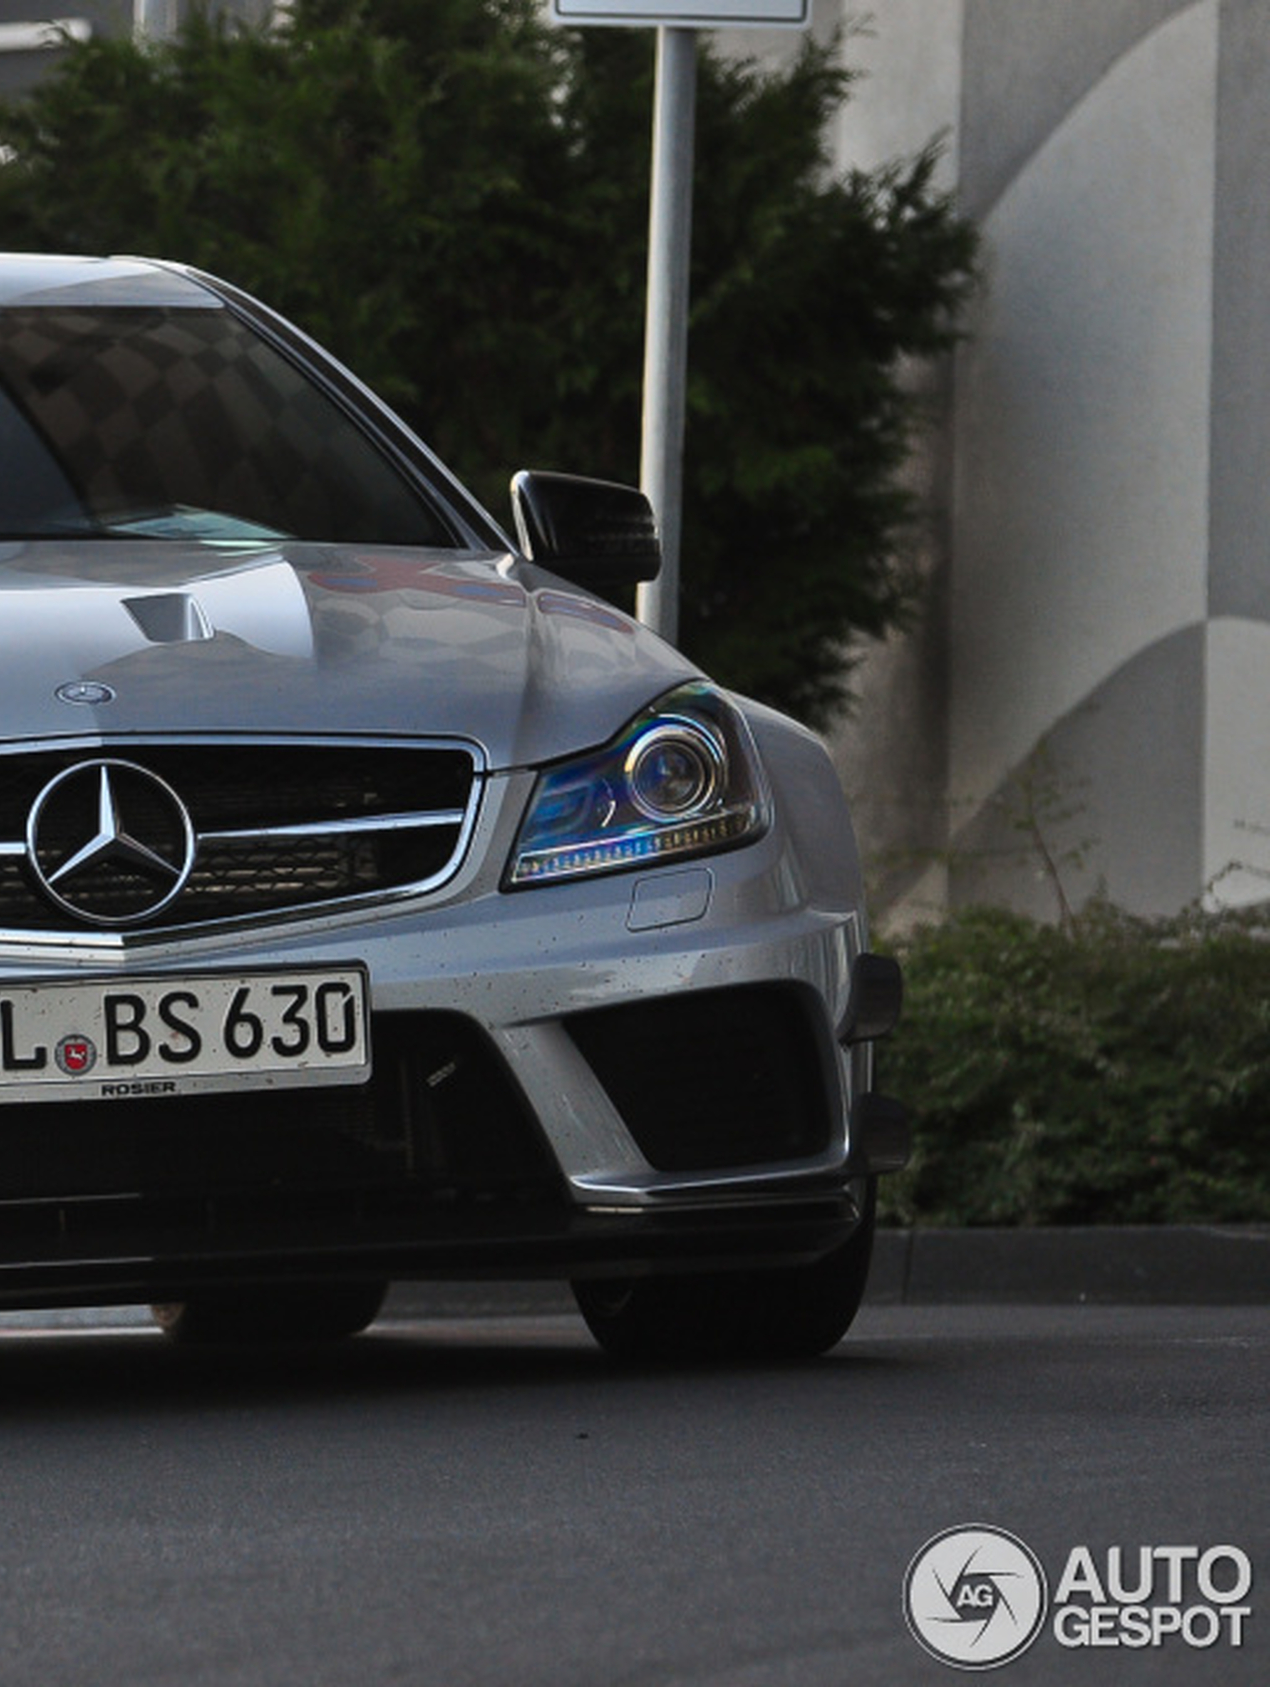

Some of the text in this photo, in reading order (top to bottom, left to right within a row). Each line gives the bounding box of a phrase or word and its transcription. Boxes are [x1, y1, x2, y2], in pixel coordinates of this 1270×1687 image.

[103, 991, 203, 1067] BS
[224, 981, 356, 1058] 630
[101, 1081, 176, 1097] ROSIER
